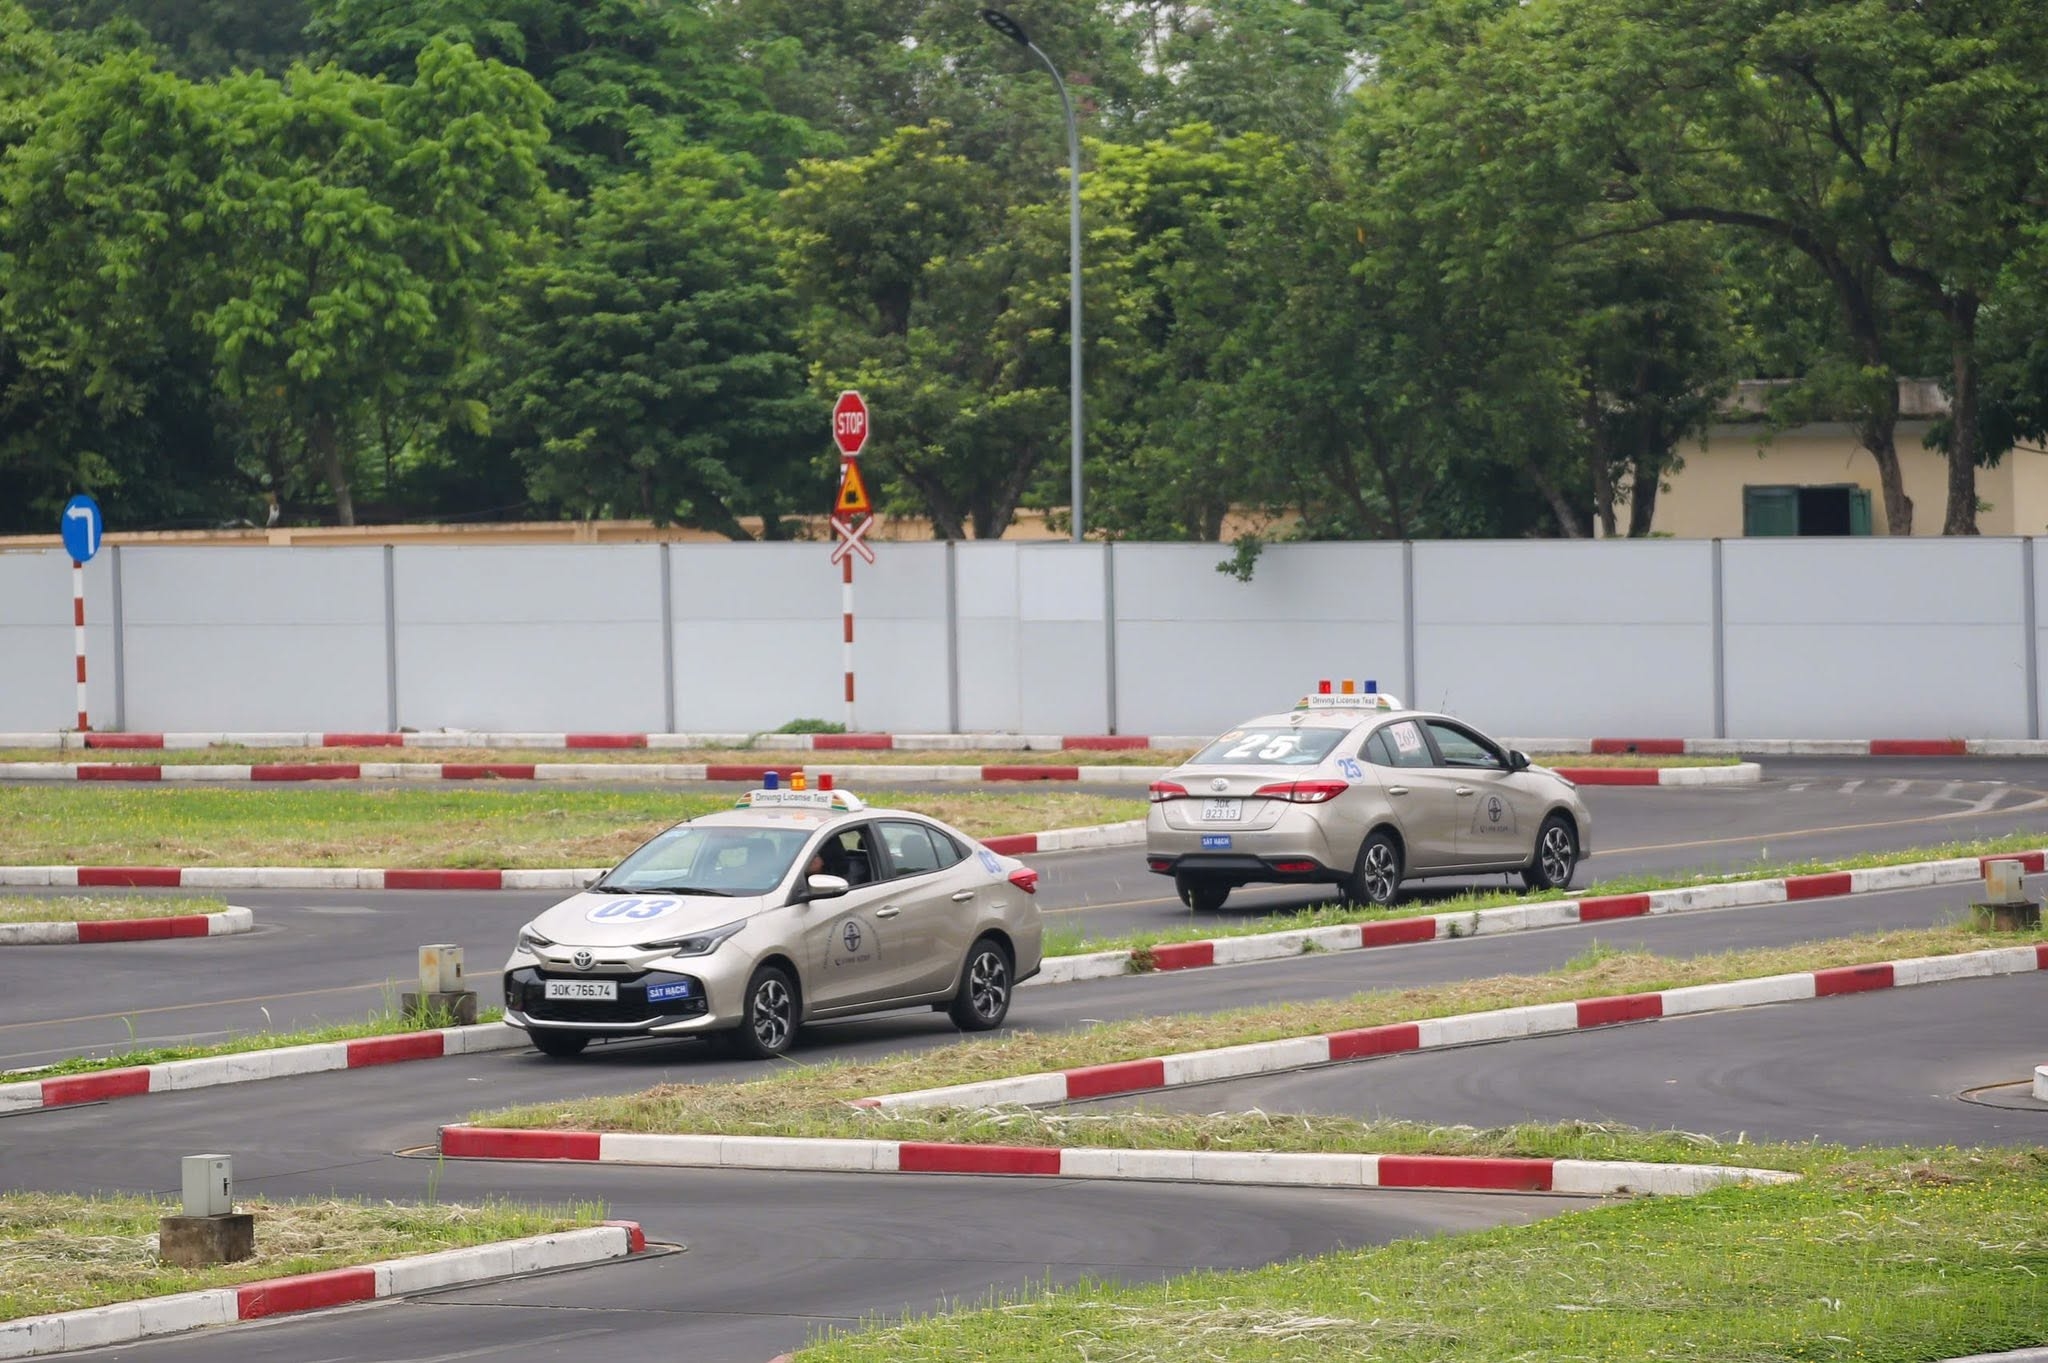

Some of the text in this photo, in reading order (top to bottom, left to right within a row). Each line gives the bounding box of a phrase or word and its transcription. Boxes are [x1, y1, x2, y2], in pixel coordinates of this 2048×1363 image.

[837, 412, 864, 435] STOP
[1313, 696, 1375, 705] Driving License Test
[1223, 734, 1302, 760] 25
[1395, 728, 1416, 747] 269
[1337, 757, 1362, 779] 25
[755, 792, 828, 803] Driving License Test
[593, 899, 677, 919] 03
[551, 984, 611, 997] 30K-766.74
[649, 985, 686, 998] SÁT HẠCH
